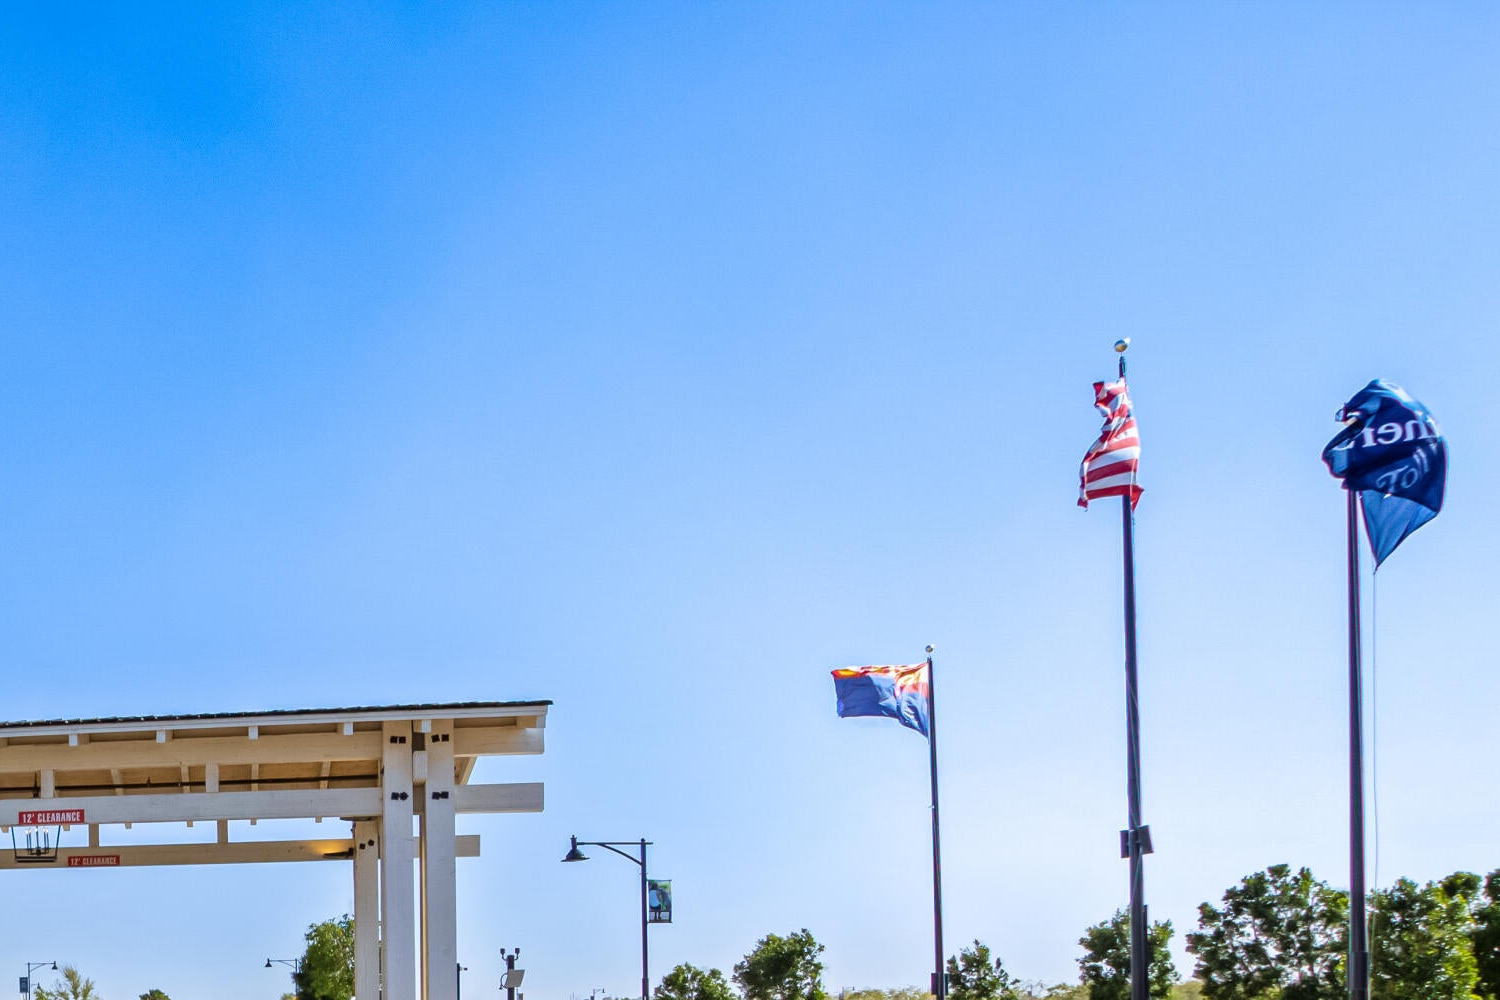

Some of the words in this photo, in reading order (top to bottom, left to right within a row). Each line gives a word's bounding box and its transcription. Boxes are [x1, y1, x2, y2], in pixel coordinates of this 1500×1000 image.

[22, 813, 35, 824] 12'
[37, 811, 81, 822] CLEARANCE
[82, 857, 117, 865] CLEARANCE
